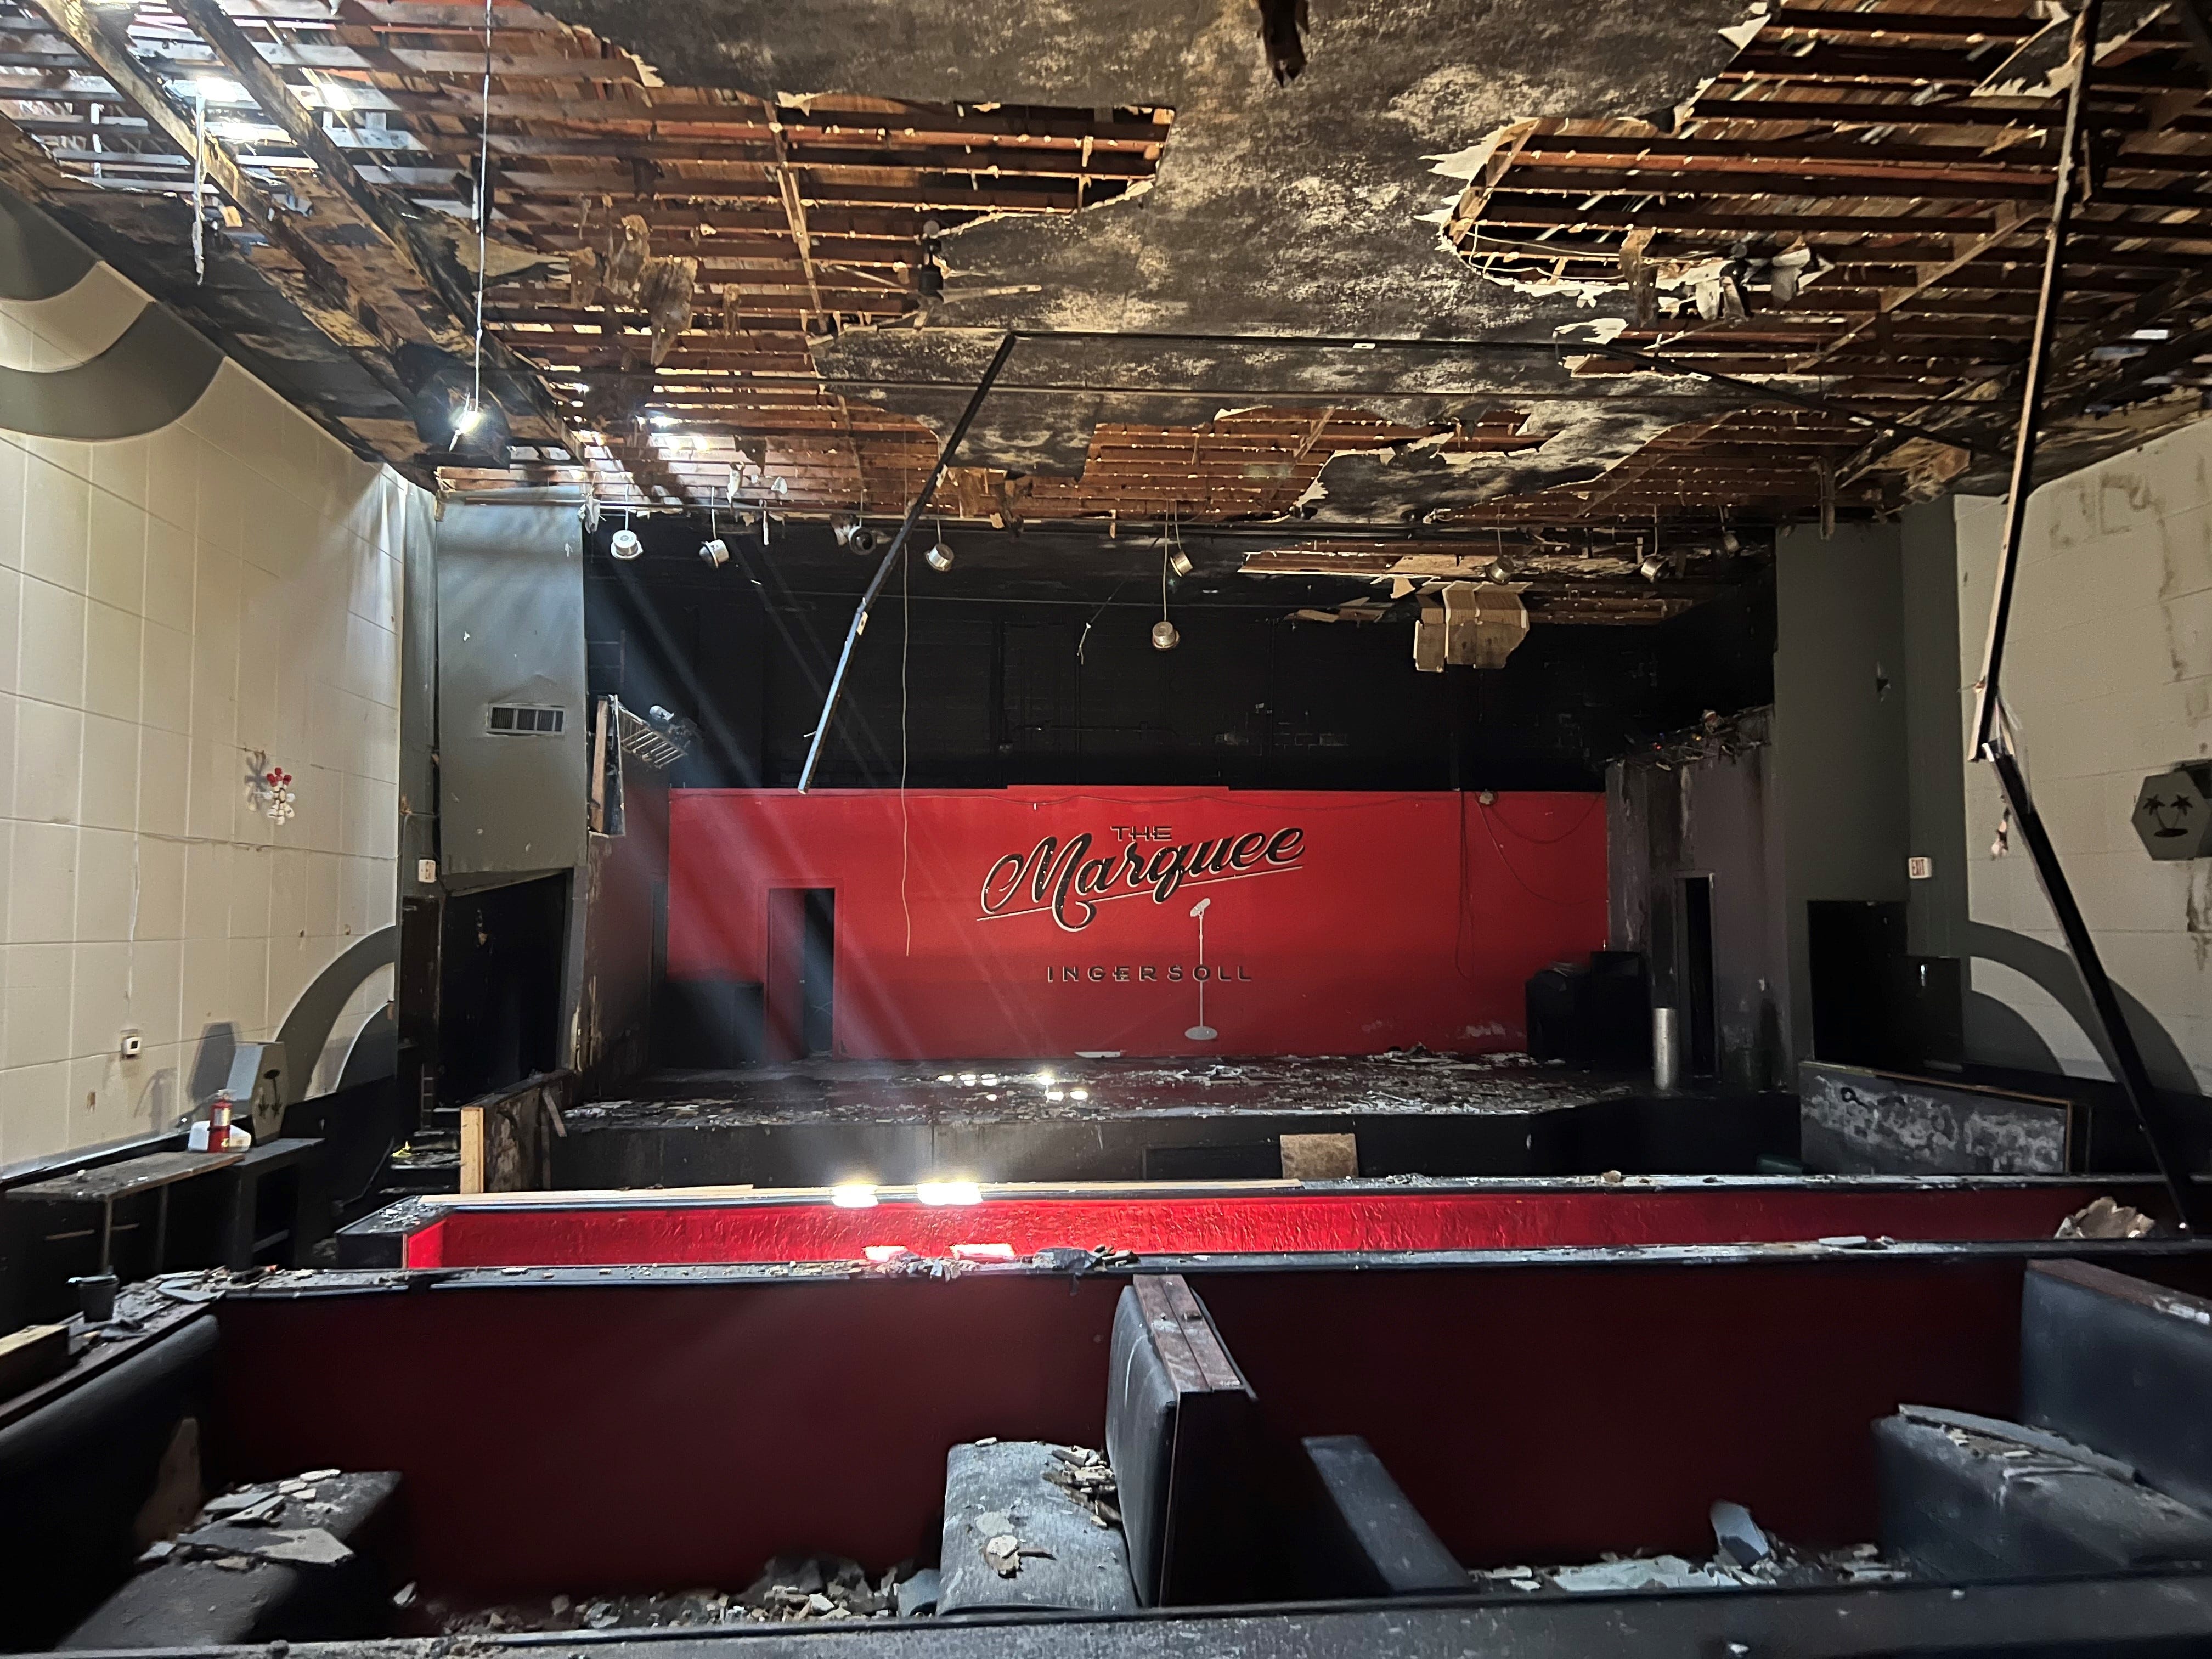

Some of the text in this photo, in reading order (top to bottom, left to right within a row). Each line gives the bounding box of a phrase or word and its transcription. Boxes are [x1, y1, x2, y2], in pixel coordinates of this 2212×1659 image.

[1111, 826, 1172, 841] THE
[981, 827, 1305, 932] Marquee
[1047, 964, 1251, 982] INGERSOLL
